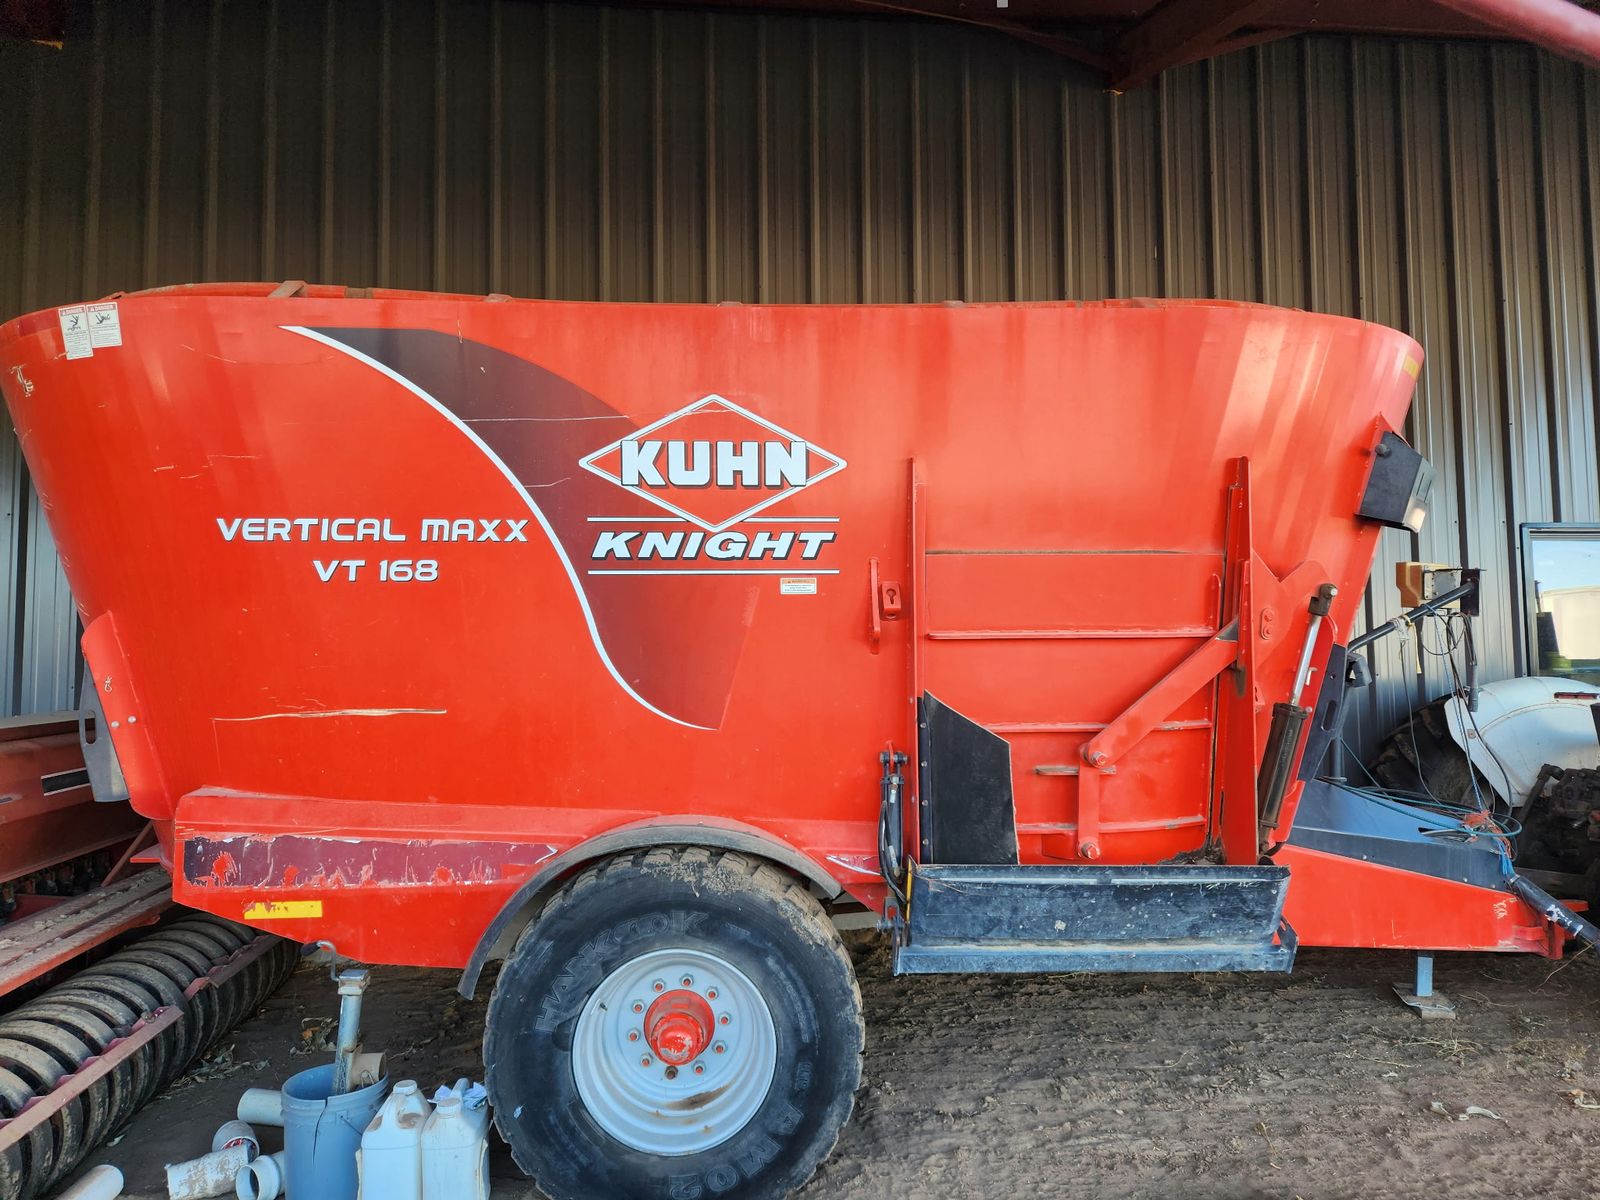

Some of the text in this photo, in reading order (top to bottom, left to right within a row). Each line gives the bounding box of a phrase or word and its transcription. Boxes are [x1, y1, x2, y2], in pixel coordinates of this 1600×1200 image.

[620, 440, 807, 488] KUHN
[216, 518, 529, 543] VERTICAL MAXX
[591, 531, 838, 560] KNIGHT
[312, 559, 439, 582] VT 168
[534, 909, 711, 1032] HANKOOK
